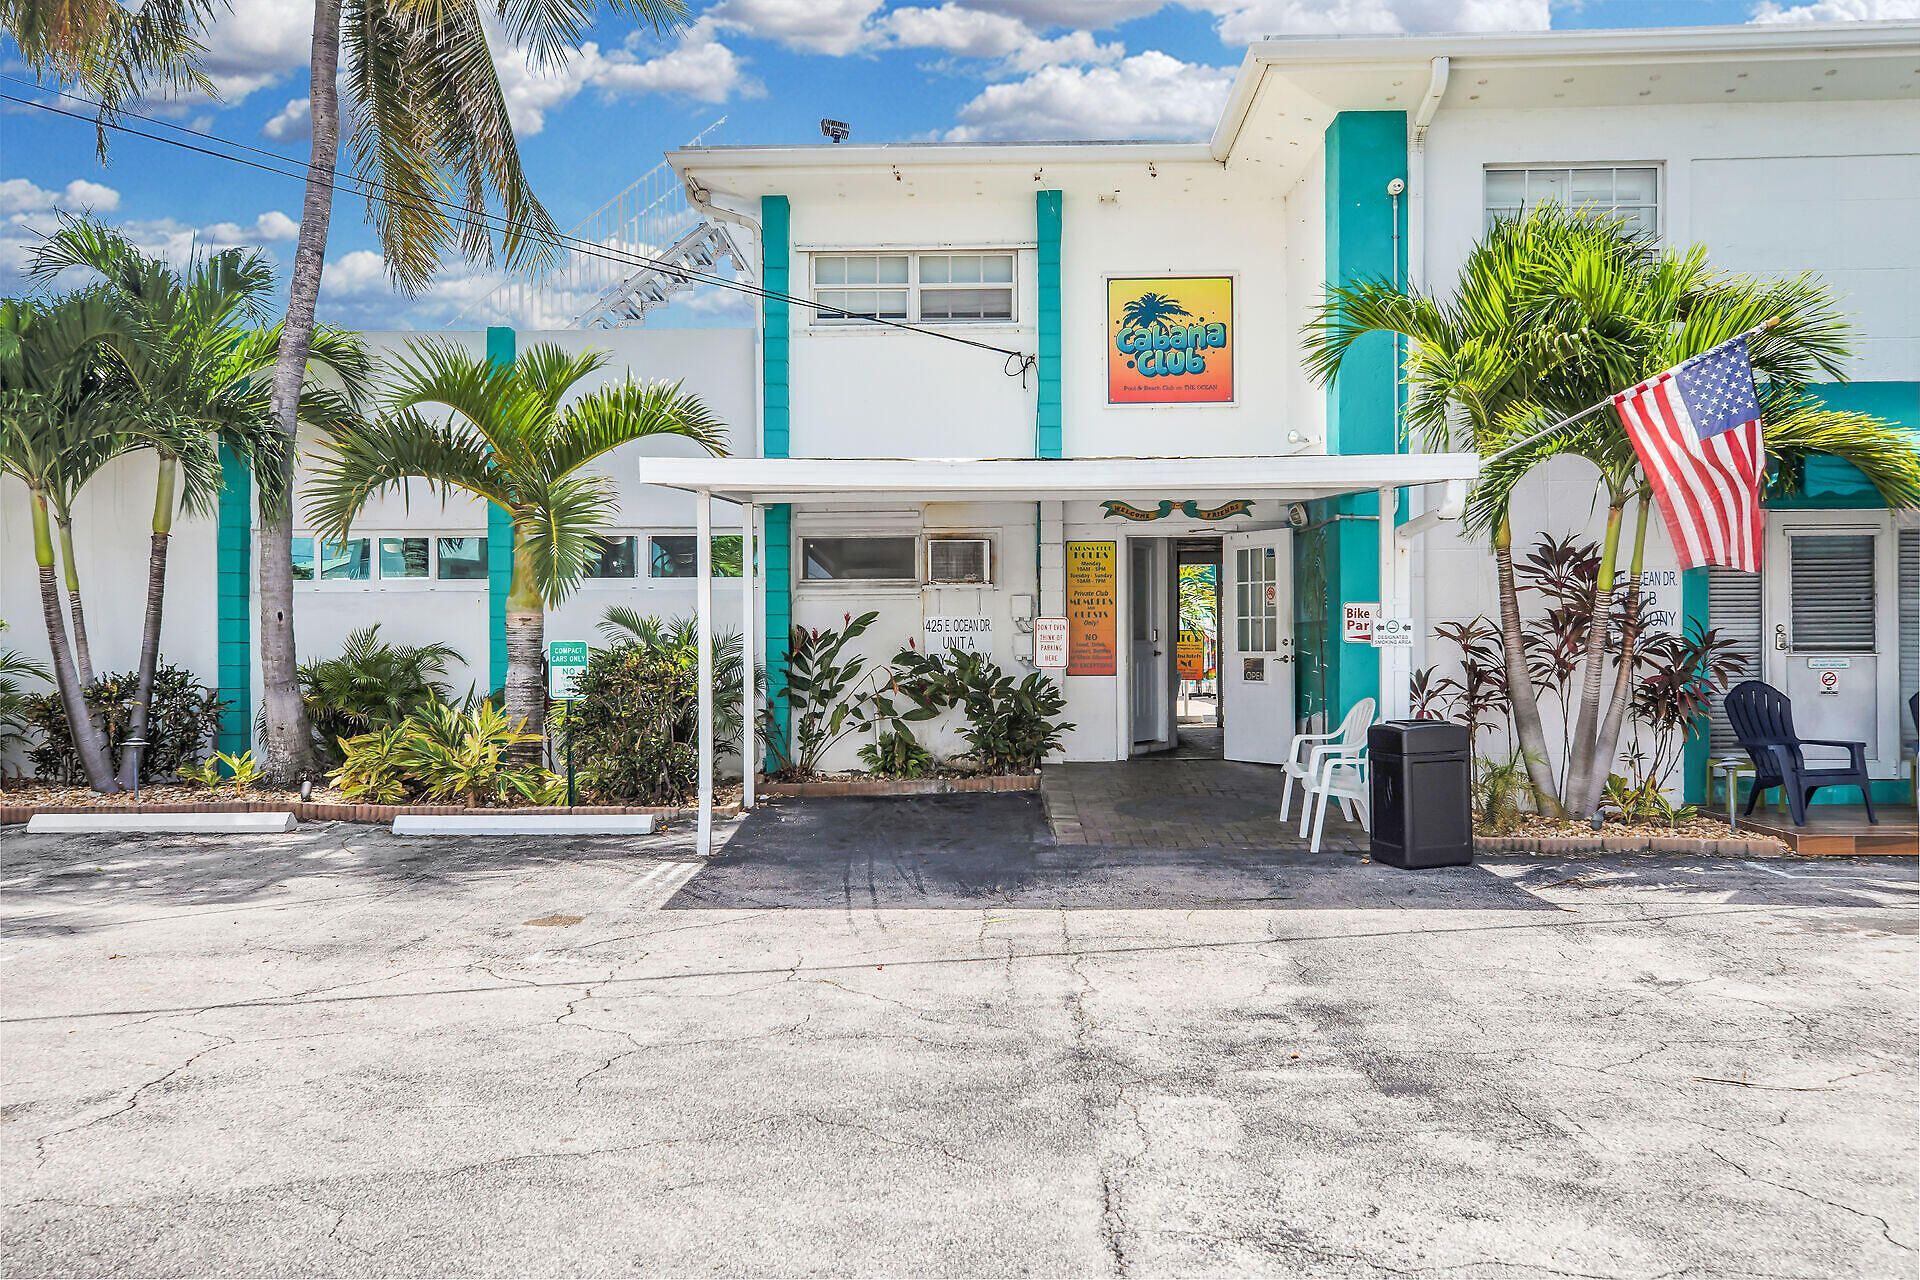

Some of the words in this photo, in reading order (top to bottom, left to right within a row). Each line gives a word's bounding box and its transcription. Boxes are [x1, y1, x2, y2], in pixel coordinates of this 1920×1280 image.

[1116, 323, 1226, 354] Cabana
[1137, 346, 1206, 377] Club
[1114, 505, 1150, 519] WELCOME
[1206, 504, 1239, 518] FRIENDS
[1663, 571, 1678, 586] DR.
[1346, 607, 1370, 618] Bike
[925, 620, 943, 632] 425
[945, 620, 951, 632] E.
[953, 619, 979, 632] OCEAN
[980, 619, 992, 632] DR.
[1347, 620, 1370, 630] Par
[942, 636, 966, 649] UNIT
[967, 637, 975, 649] A
[1246, 672, 1264, 680] OPEN
